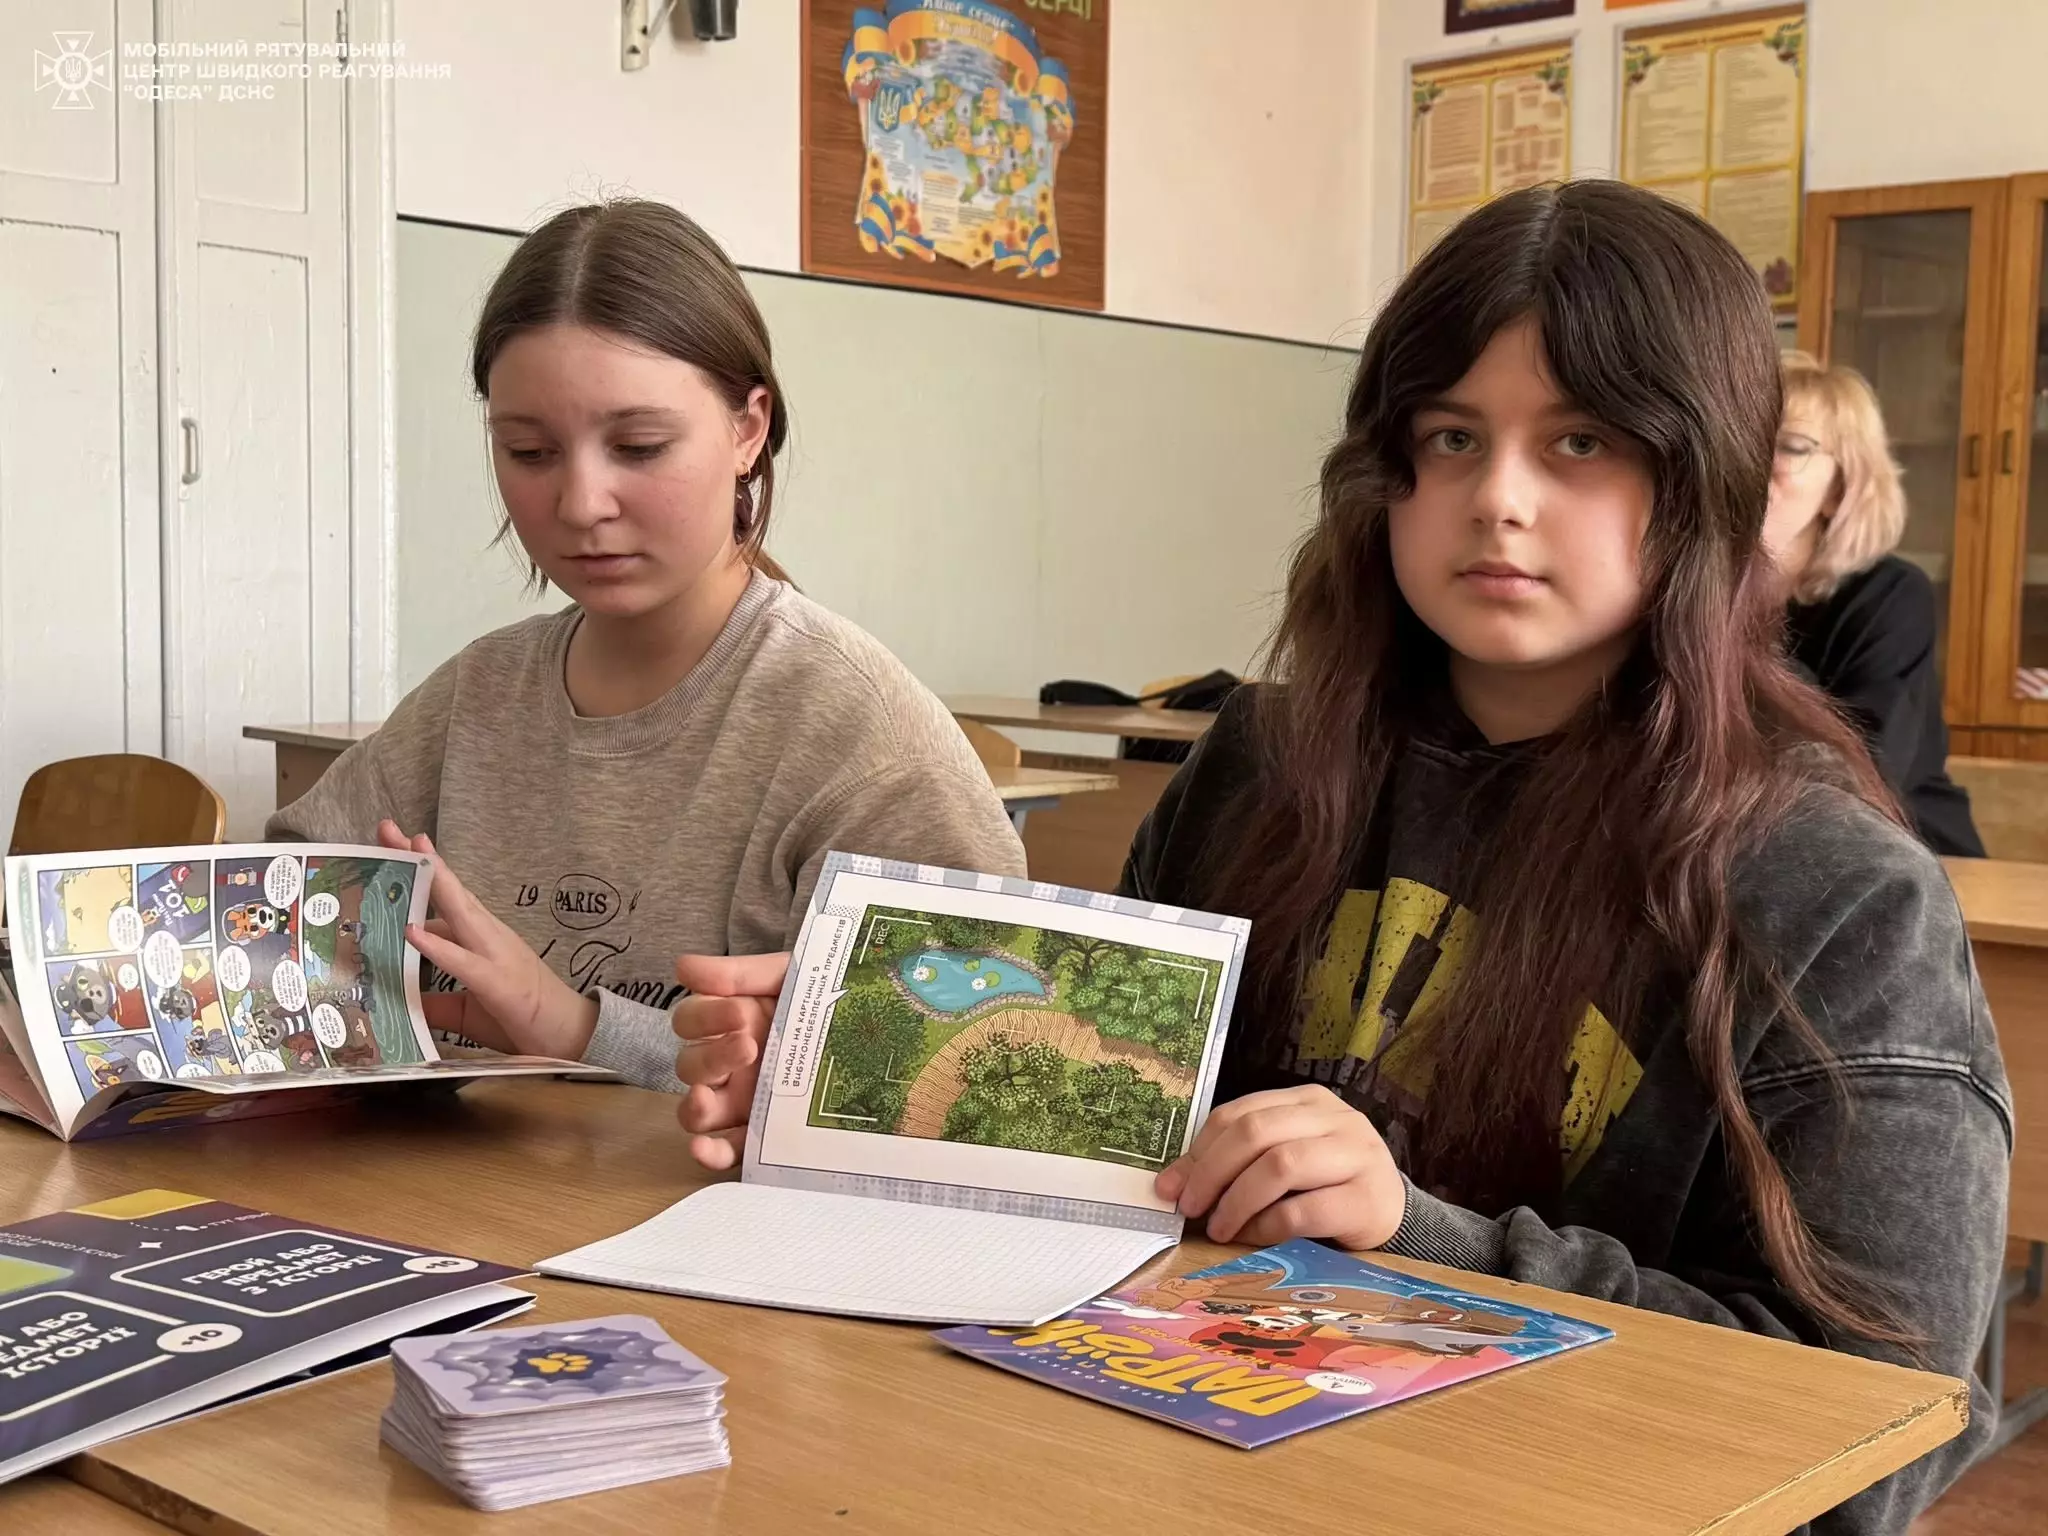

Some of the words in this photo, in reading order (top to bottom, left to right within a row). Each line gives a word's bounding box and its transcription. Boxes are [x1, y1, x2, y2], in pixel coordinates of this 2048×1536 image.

[158, 879, 190, 918] 101
[515, 884, 539, 906] 19
[555, 888, 608, 914] PARIS
[825, 919, 847, 971] ПРЕДМЕТІВ
[875, 922, 890, 945] REC
[782, 1044, 798, 1087] ЗНАЙДИ
[794, 1026, 802, 1041] НА
[799, 975, 817, 1024] КАРТИНЦІ
[181, 1256, 275, 1285] ГЕРОЙ
[276, 1243, 335, 1261] АБО
[222, 1251, 349, 1287] ПРЕДМЕТ
[267, 1254, 383, 1288] ІСТОРІЇ
[20, 1311, 89, 1336] АБО
[1, 1326, 138, 1379] ІСТОРІЇ
